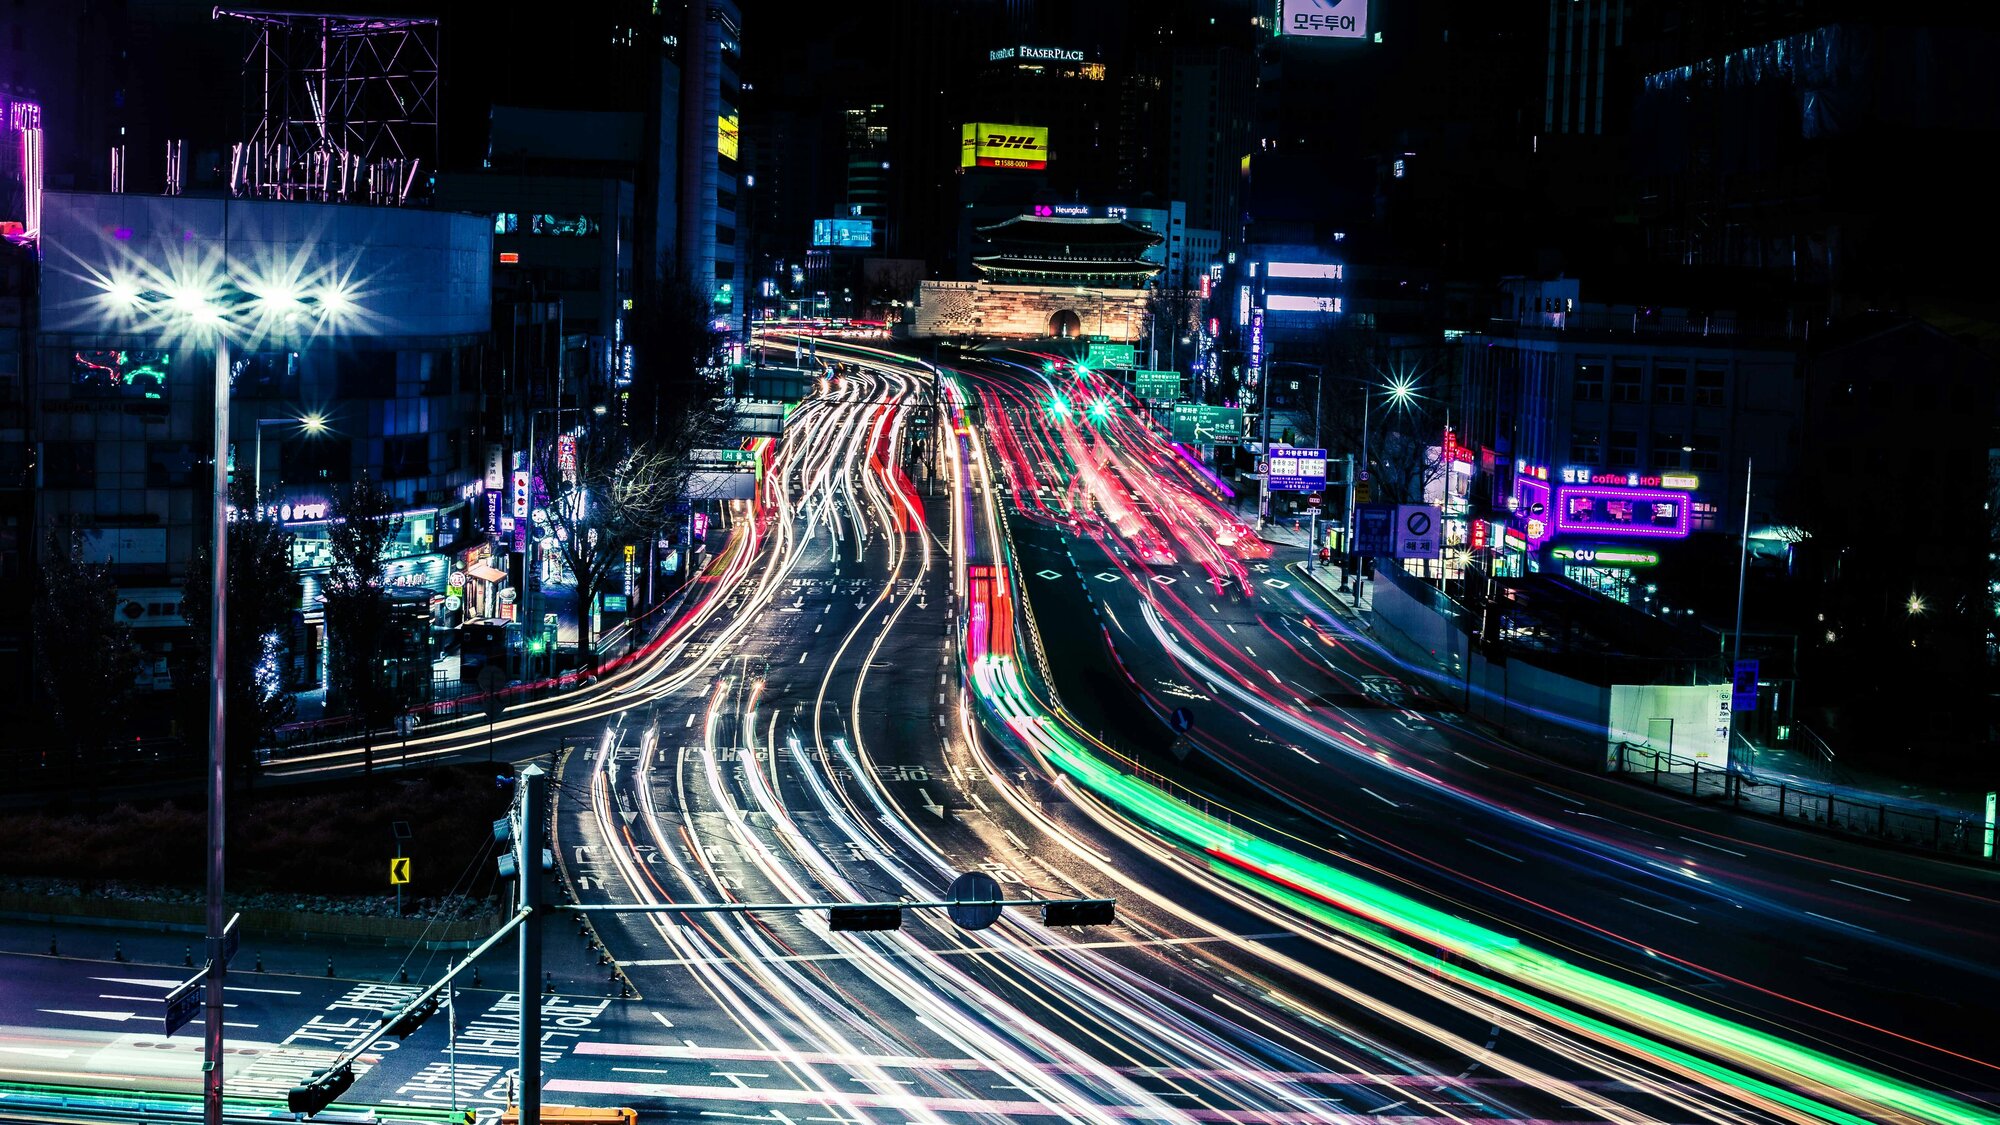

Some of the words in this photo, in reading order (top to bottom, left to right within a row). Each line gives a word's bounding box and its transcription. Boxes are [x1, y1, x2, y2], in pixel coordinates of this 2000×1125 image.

[1293, 13, 1355, 32] 모두투어
[986, 134, 1040, 150] DHL
[1000, 159, 1029, 168] 1588-0001
[1055, 206, 1089, 215] Heungkuk
[725, 452, 753, 460] 서울역
[1592, 474, 1627, 485] coffee
[1628, 475, 1638, 485] &
[1640, 477, 1661, 485] HOF
[1575, 549, 1595, 561] CU
